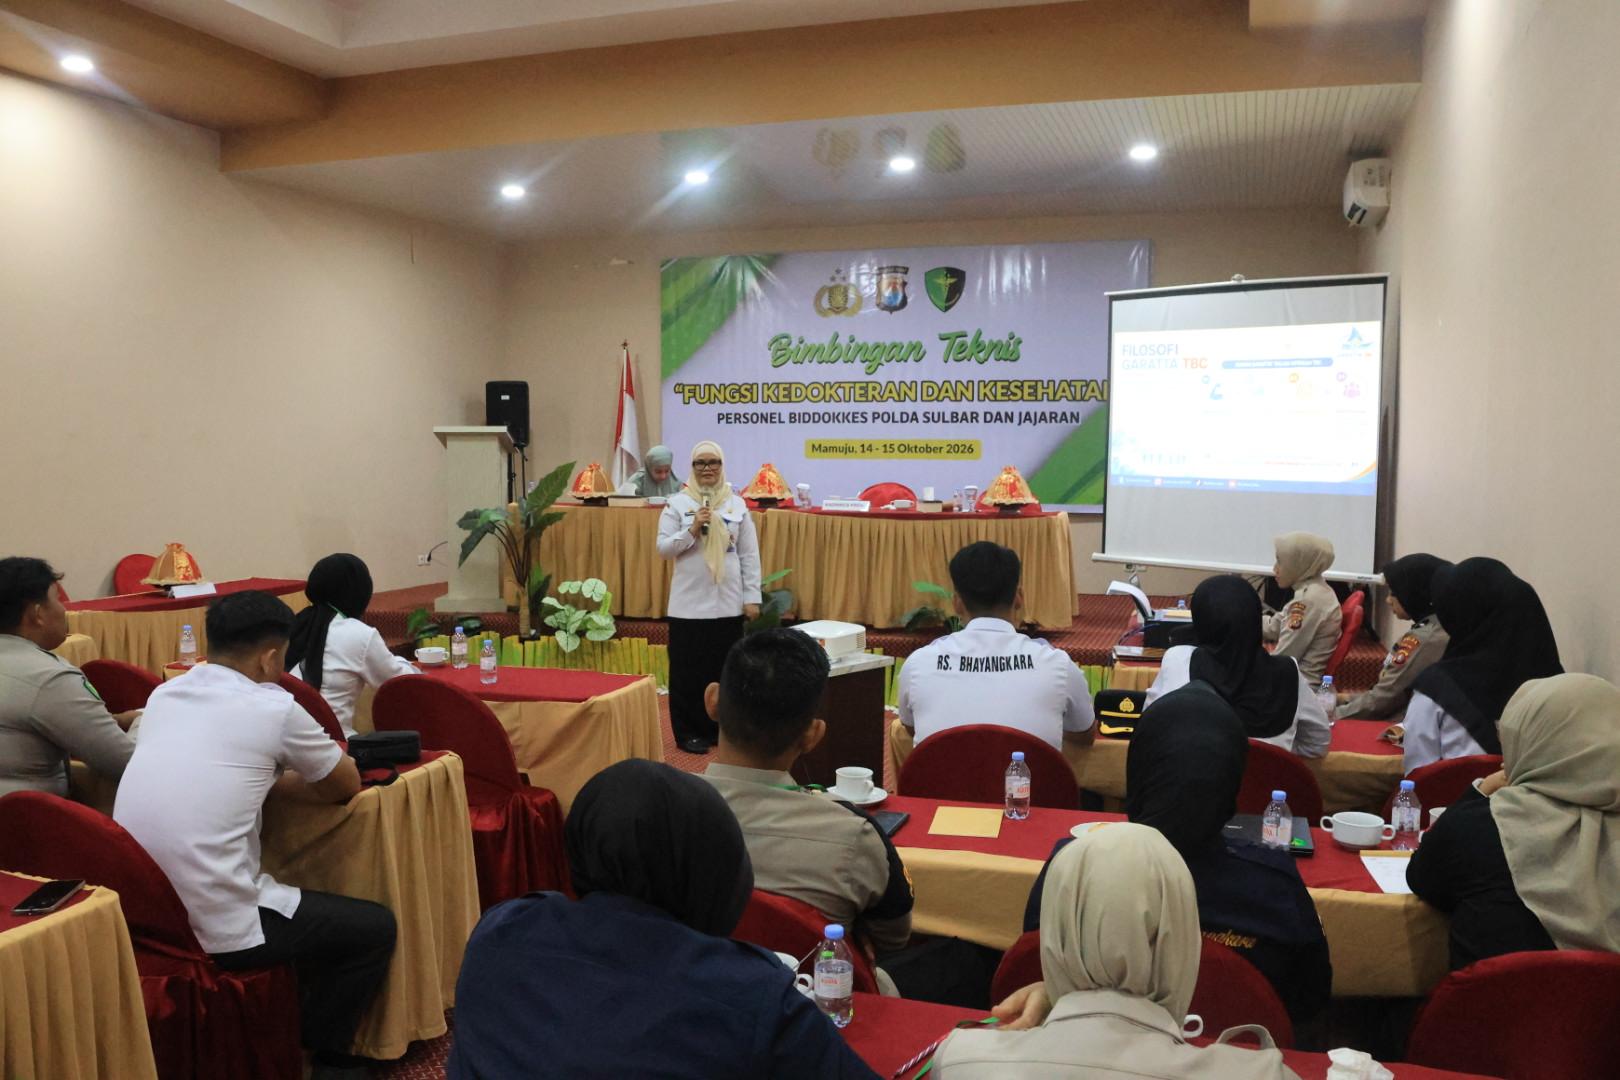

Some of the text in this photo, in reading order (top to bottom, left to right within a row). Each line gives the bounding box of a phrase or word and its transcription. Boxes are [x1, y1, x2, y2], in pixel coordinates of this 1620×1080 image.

[767, 328, 1023, 375] Bimbingan Teknis
[1121, 343, 1179, 357] FILOSOFI
[1183, 356, 1208, 369] TBC
[761, 380, 918, 404] KEDOKTERAN
[921, 380, 975, 402] DAN
[717, 411, 1081, 426] PERSONEL BIDDOKKES POLDA SULBAR DAN JAJARAN
[811, 443, 858, 456] Mamuju,
[860, 443, 873, 454] 14
[882, 443, 896, 454] 15
[897, 443, 944, 454] Oktober
[946, 443, 975, 454] 2026
[936, 654, 1034, 673] RS. BHAYANGKARA
